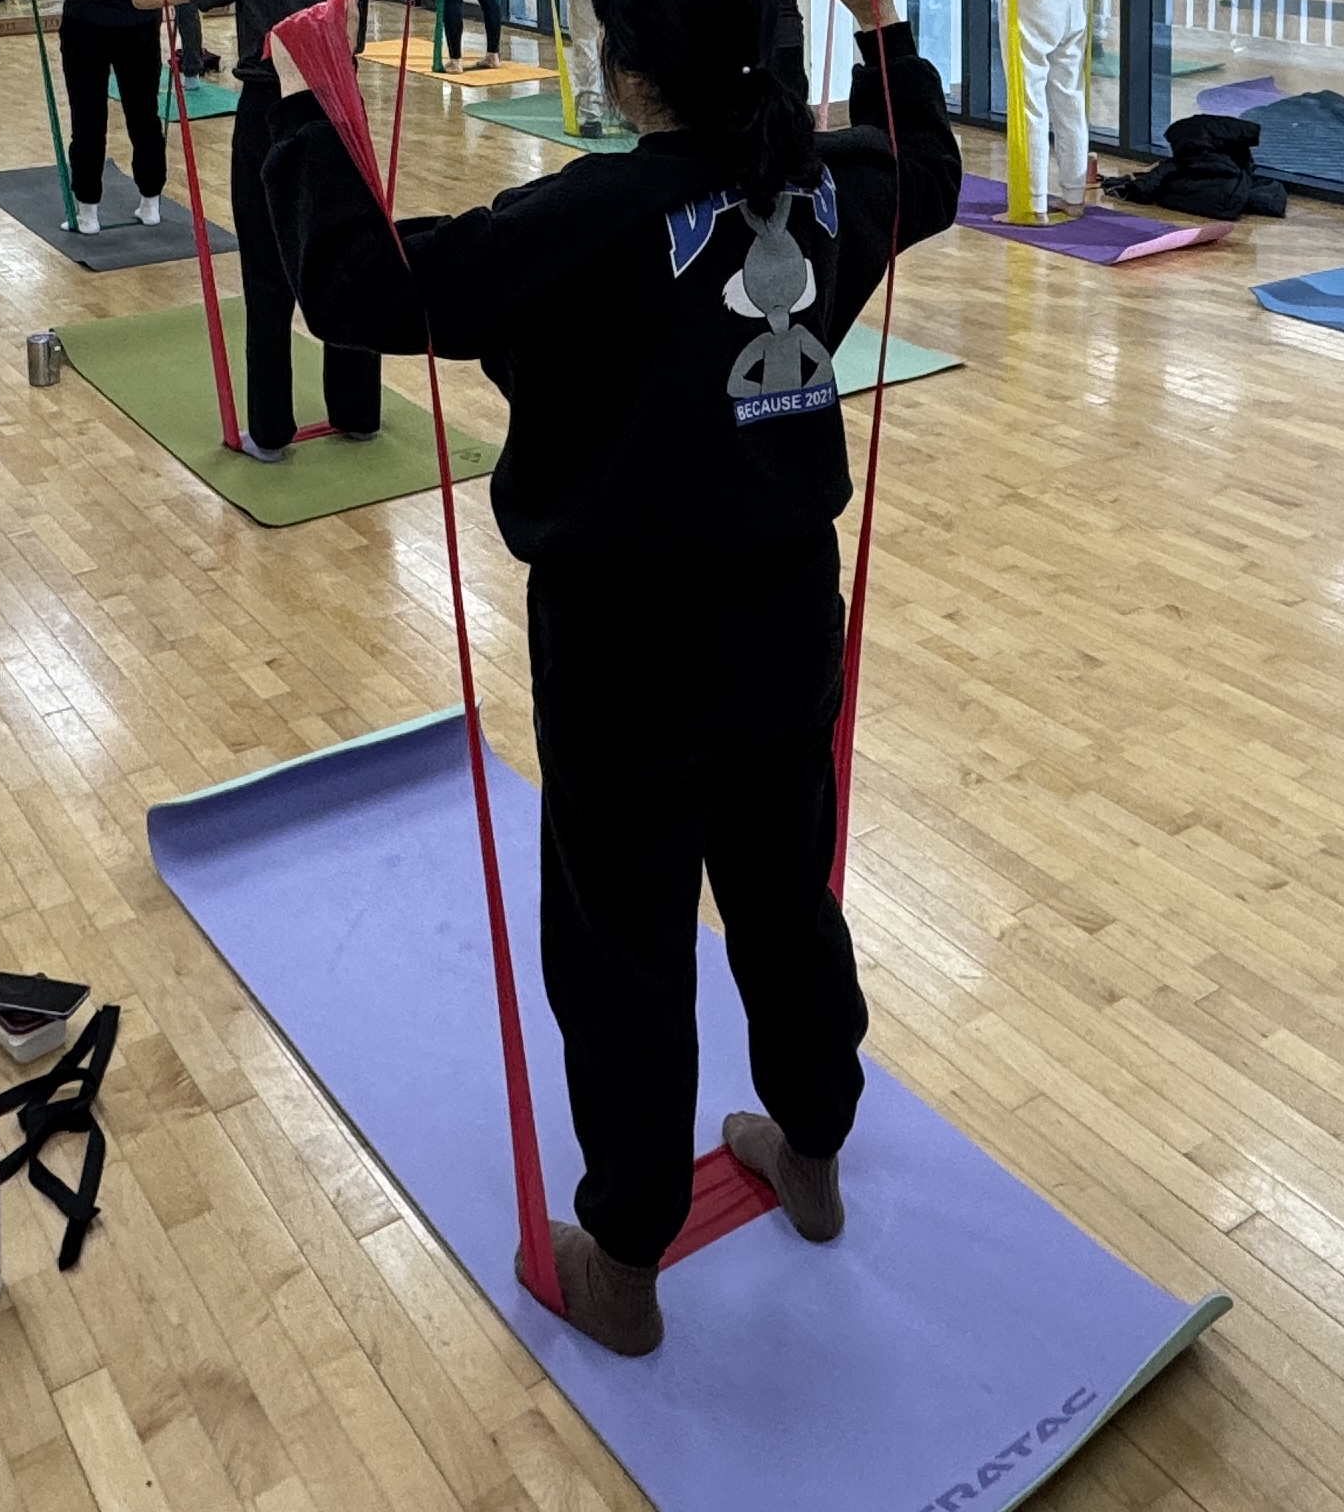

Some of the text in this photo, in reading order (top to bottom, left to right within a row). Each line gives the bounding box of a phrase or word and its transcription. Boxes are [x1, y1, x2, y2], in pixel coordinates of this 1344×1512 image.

[736, 387, 833, 421] BECAUSE 2021
[920, 1386, 1098, 1512] RATAC
